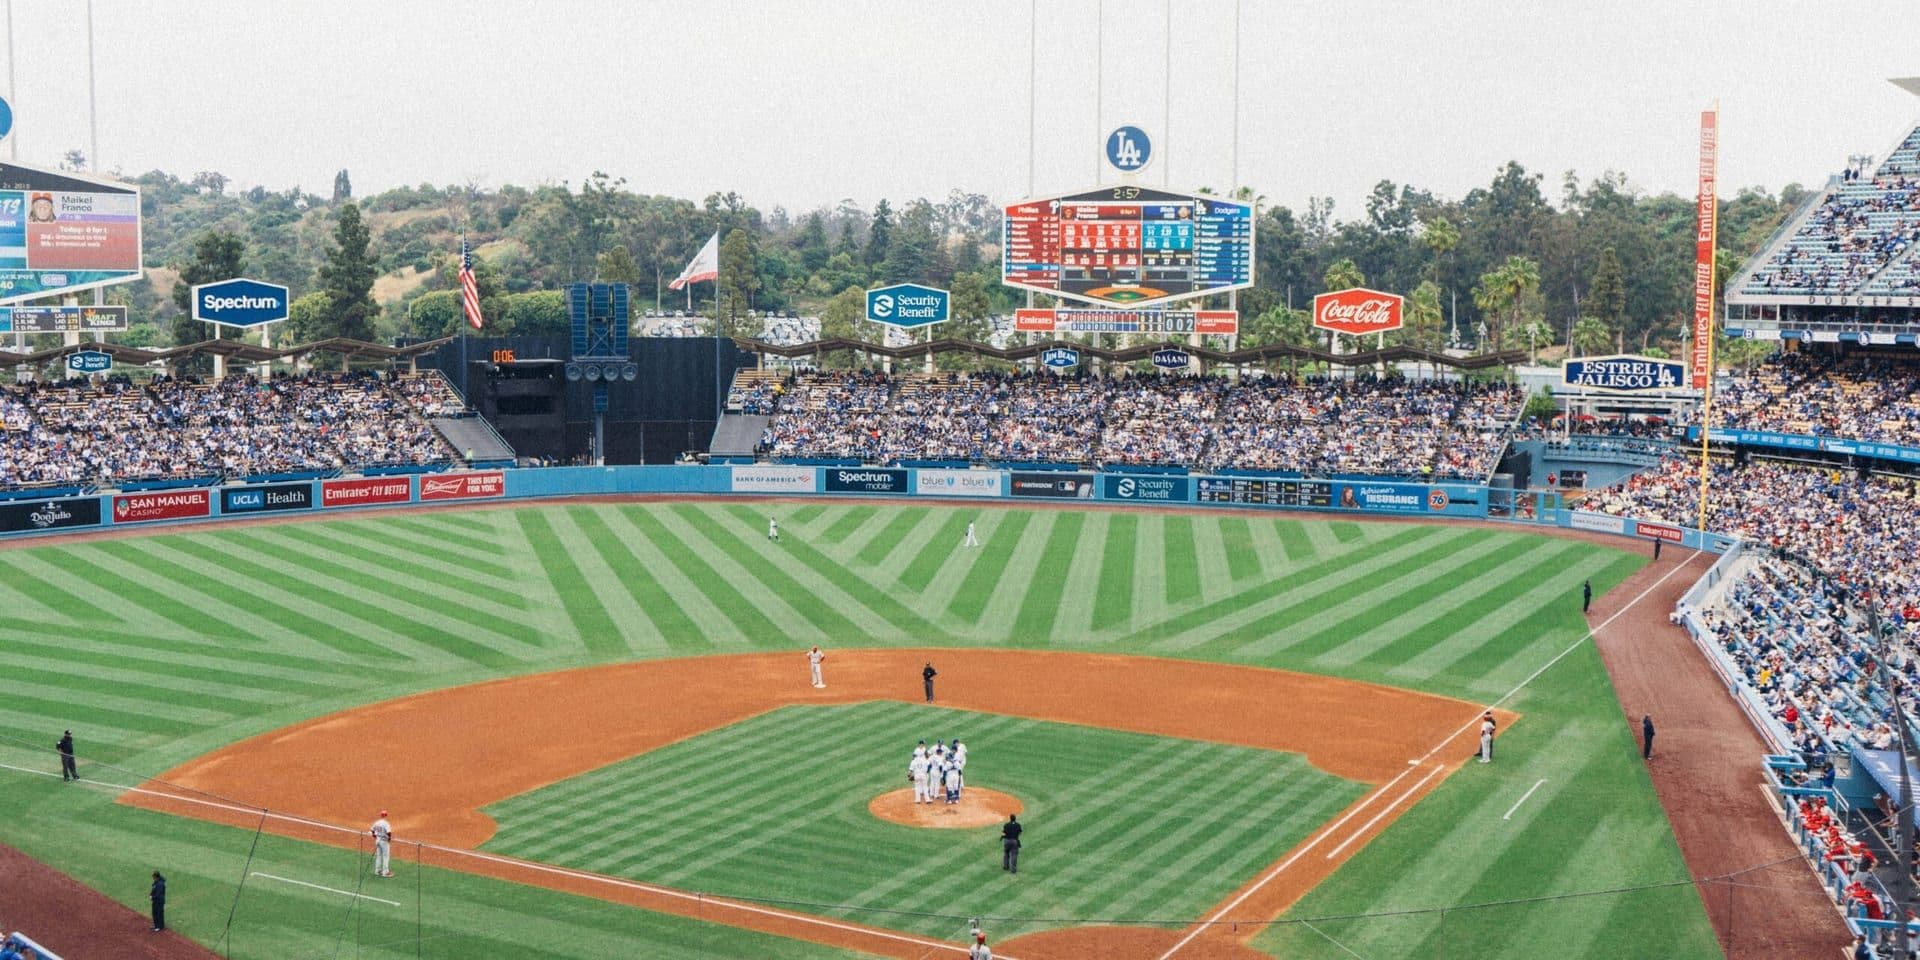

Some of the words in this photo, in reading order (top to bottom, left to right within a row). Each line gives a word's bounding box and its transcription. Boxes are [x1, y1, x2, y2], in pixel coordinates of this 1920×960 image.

[1116, 131, 1141, 166] LA
[1114, 189, 1140, 199] 2:57
[1698, 182, 1713, 242] Emirates
[1697, 263, 1710, 295] BETTER
[204, 295, 277, 313] Spectrum
[898, 295, 942, 309] Security
[1696, 297, 1709, 312] FLY
[898, 306, 935, 318] Benefit
[1321, 299, 1394, 324] Coca-Cola
[1019, 317, 1053, 325] Emirates
[1166, 318, 1173, 331] 0
[1176, 318, 1184, 331] 0
[1186, 318, 1194, 331] 2
[1693, 316, 1709, 376] Emirates
[85, 356, 108, 365] Security
[1058, 350, 1077, 363] BEAM
[1155, 354, 1187, 364] DASANI
[1573, 373, 1653, 388] JALISCO
[839, 471, 890, 485] Spectrum
[922, 477, 945, 486] blue
[962, 477, 984, 487] blue
[326, 488, 370, 499] Emirates
[372, 486, 384, 496] FLY
[384, 484, 408, 496] BETTER
[467, 485, 481, 494] FOR
[866, 482, 893, 490] mobile
[1138, 479, 1175, 492] Security
[233, 495, 260, 505] UCLA
[267, 491, 305, 504] Health
[1139, 489, 1169, 499] Benefit
[1366, 495, 1419, 505] INSURANCE
[1431, 495, 1444, 504] 76
[131, 498, 155, 509] SAN
[158, 494, 206, 507] MANUEL
